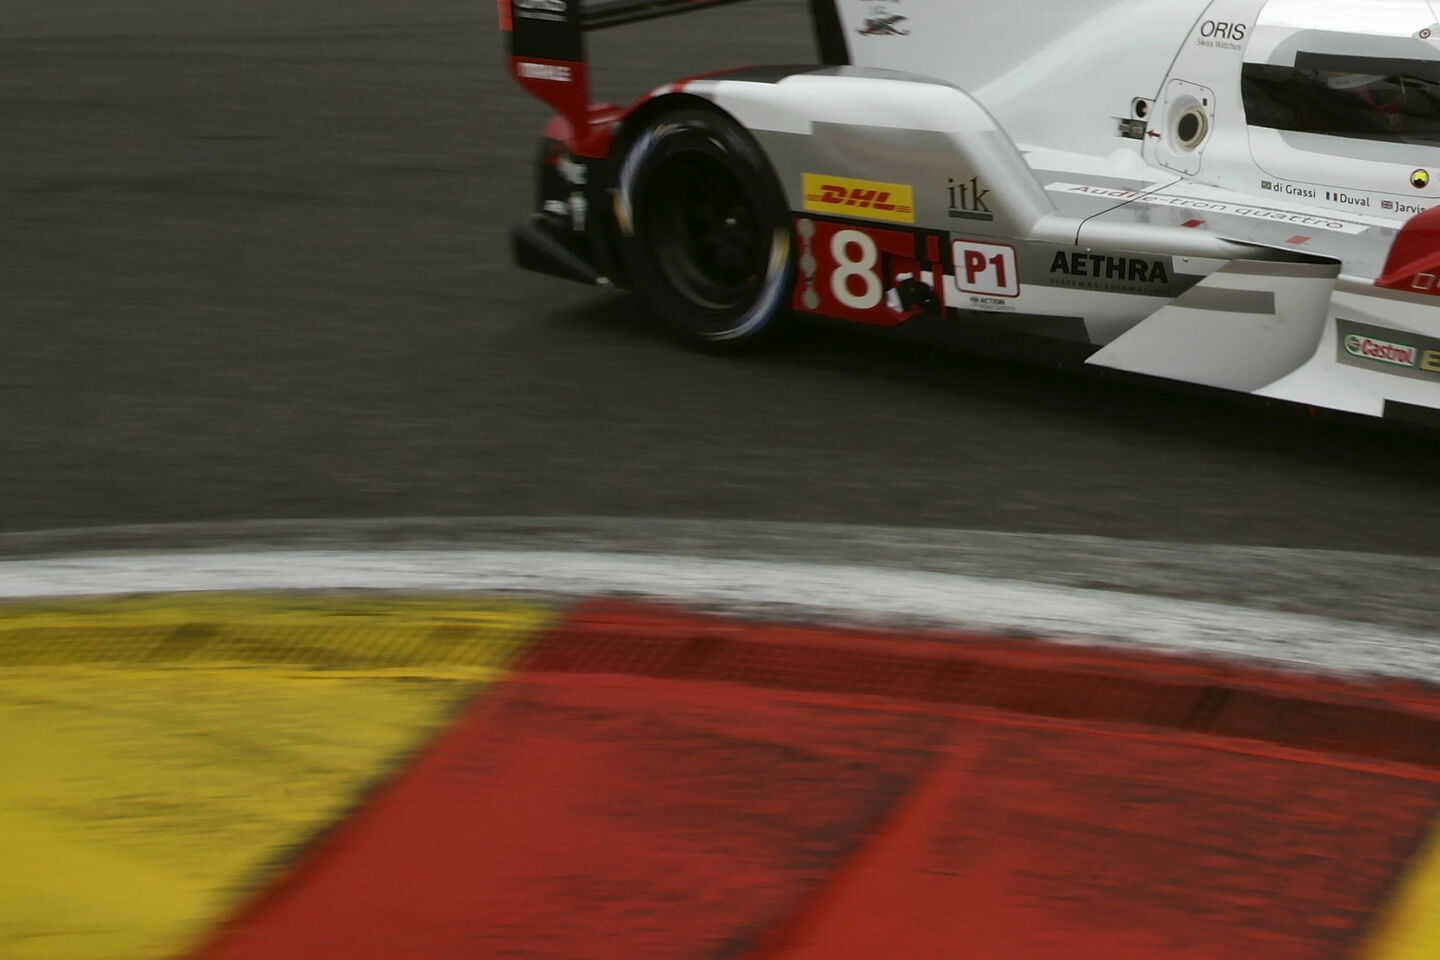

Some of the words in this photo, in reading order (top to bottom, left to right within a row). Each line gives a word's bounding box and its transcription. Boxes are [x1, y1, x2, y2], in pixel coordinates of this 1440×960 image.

[1201, 20, 1246, 40] ORIS
[820, 184, 896, 211] DHL
[947, 176, 992, 214] itk
[1273, 183, 1283, 193] di
[1285, 184, 1316, 198] Grassi
[1340, 193, 1370, 207] Duval
[1071, 184, 1138, 199] Audi
[1142, 195, 1227, 215] e-tron
[1235, 205, 1344, 229] quattro
[1394, 201, 1426, 215] Jarvis
[830, 229, 883, 310] 8
[964, 249, 1007, 288] P1
[1050, 251, 1169, 284] AETHRA
[1360, 339, 1414, 365] Castrol
